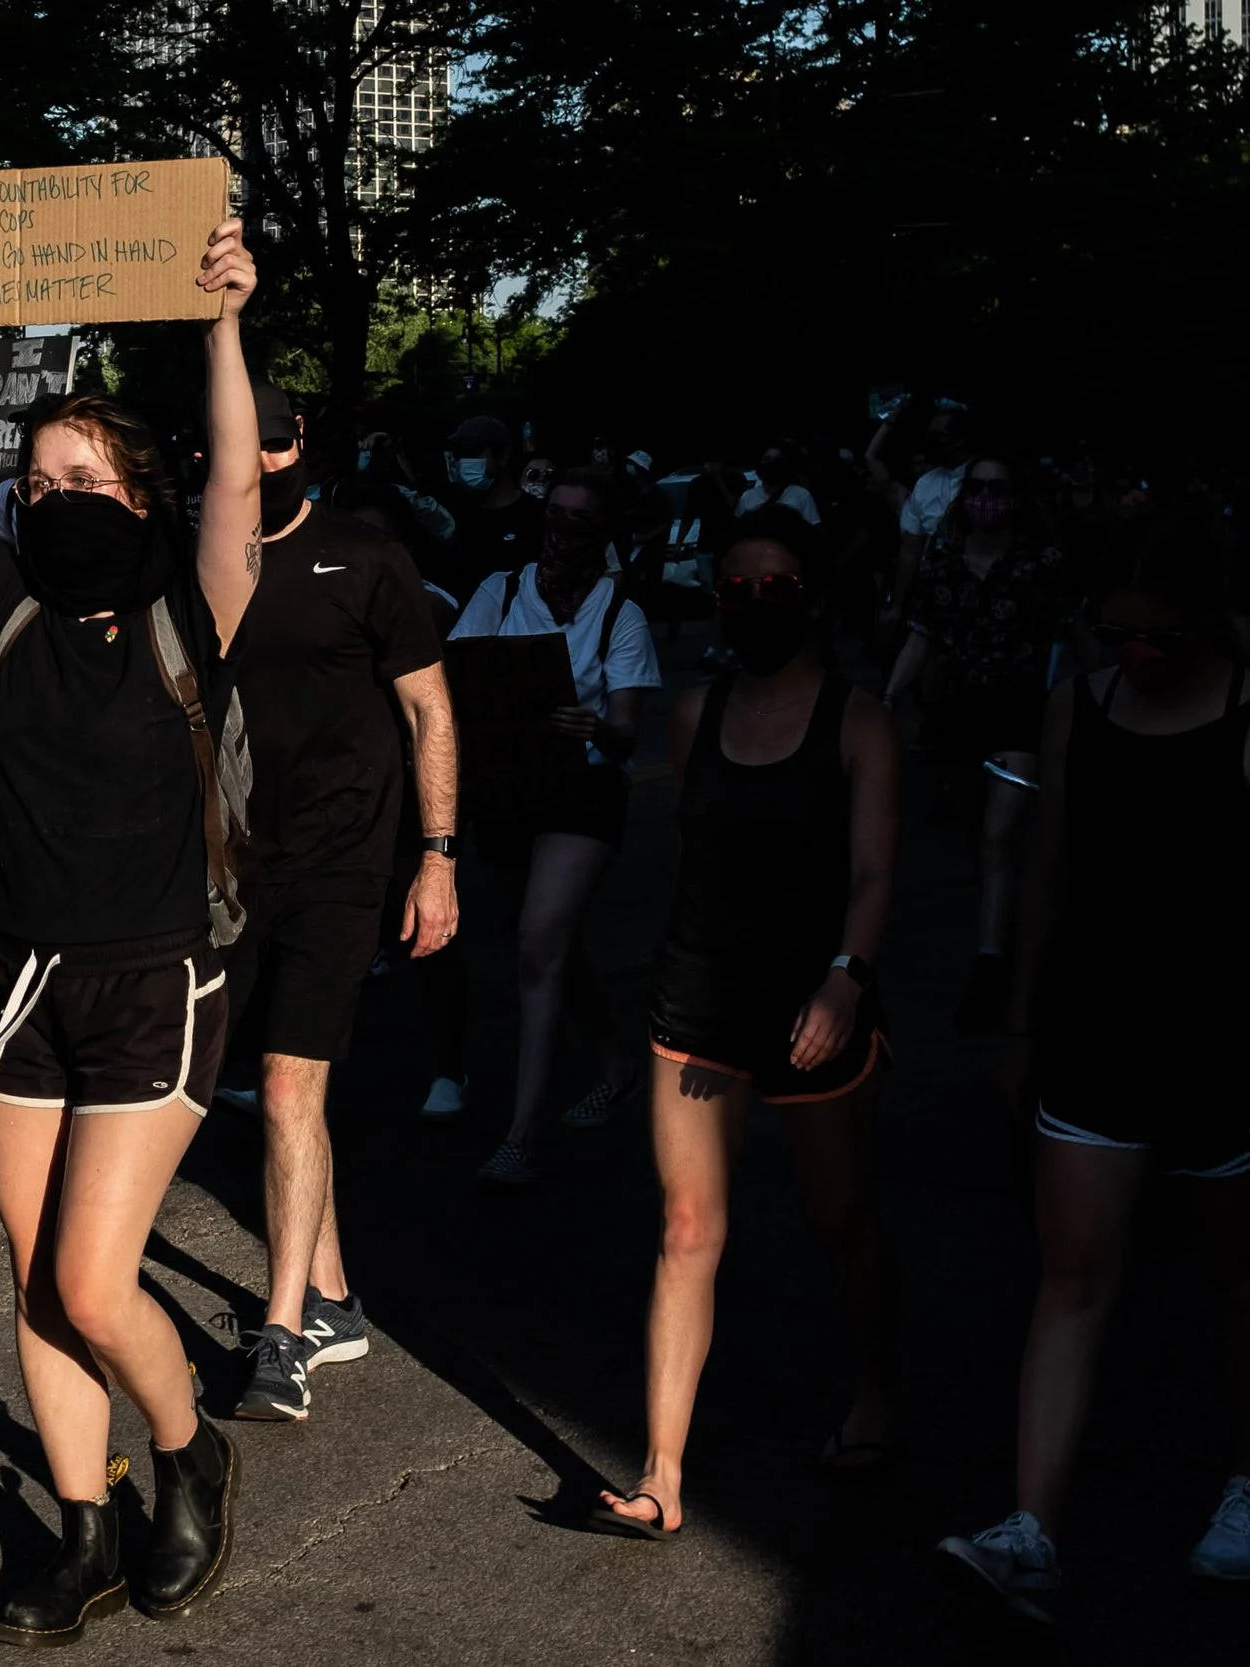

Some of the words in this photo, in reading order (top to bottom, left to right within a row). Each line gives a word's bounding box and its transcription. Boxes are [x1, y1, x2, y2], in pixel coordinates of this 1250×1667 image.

[111, 170, 154, 196] FOR
[0, 209, 35, 234] COPS
[3, 241, 25, 269] GO
[31, 242, 86, 267] HAND
[90, 238, 109, 263] IN
[115, 238, 177, 265] HAND
[25, 273, 118, 303] MATTER
[11, 337, 45, 368] I
